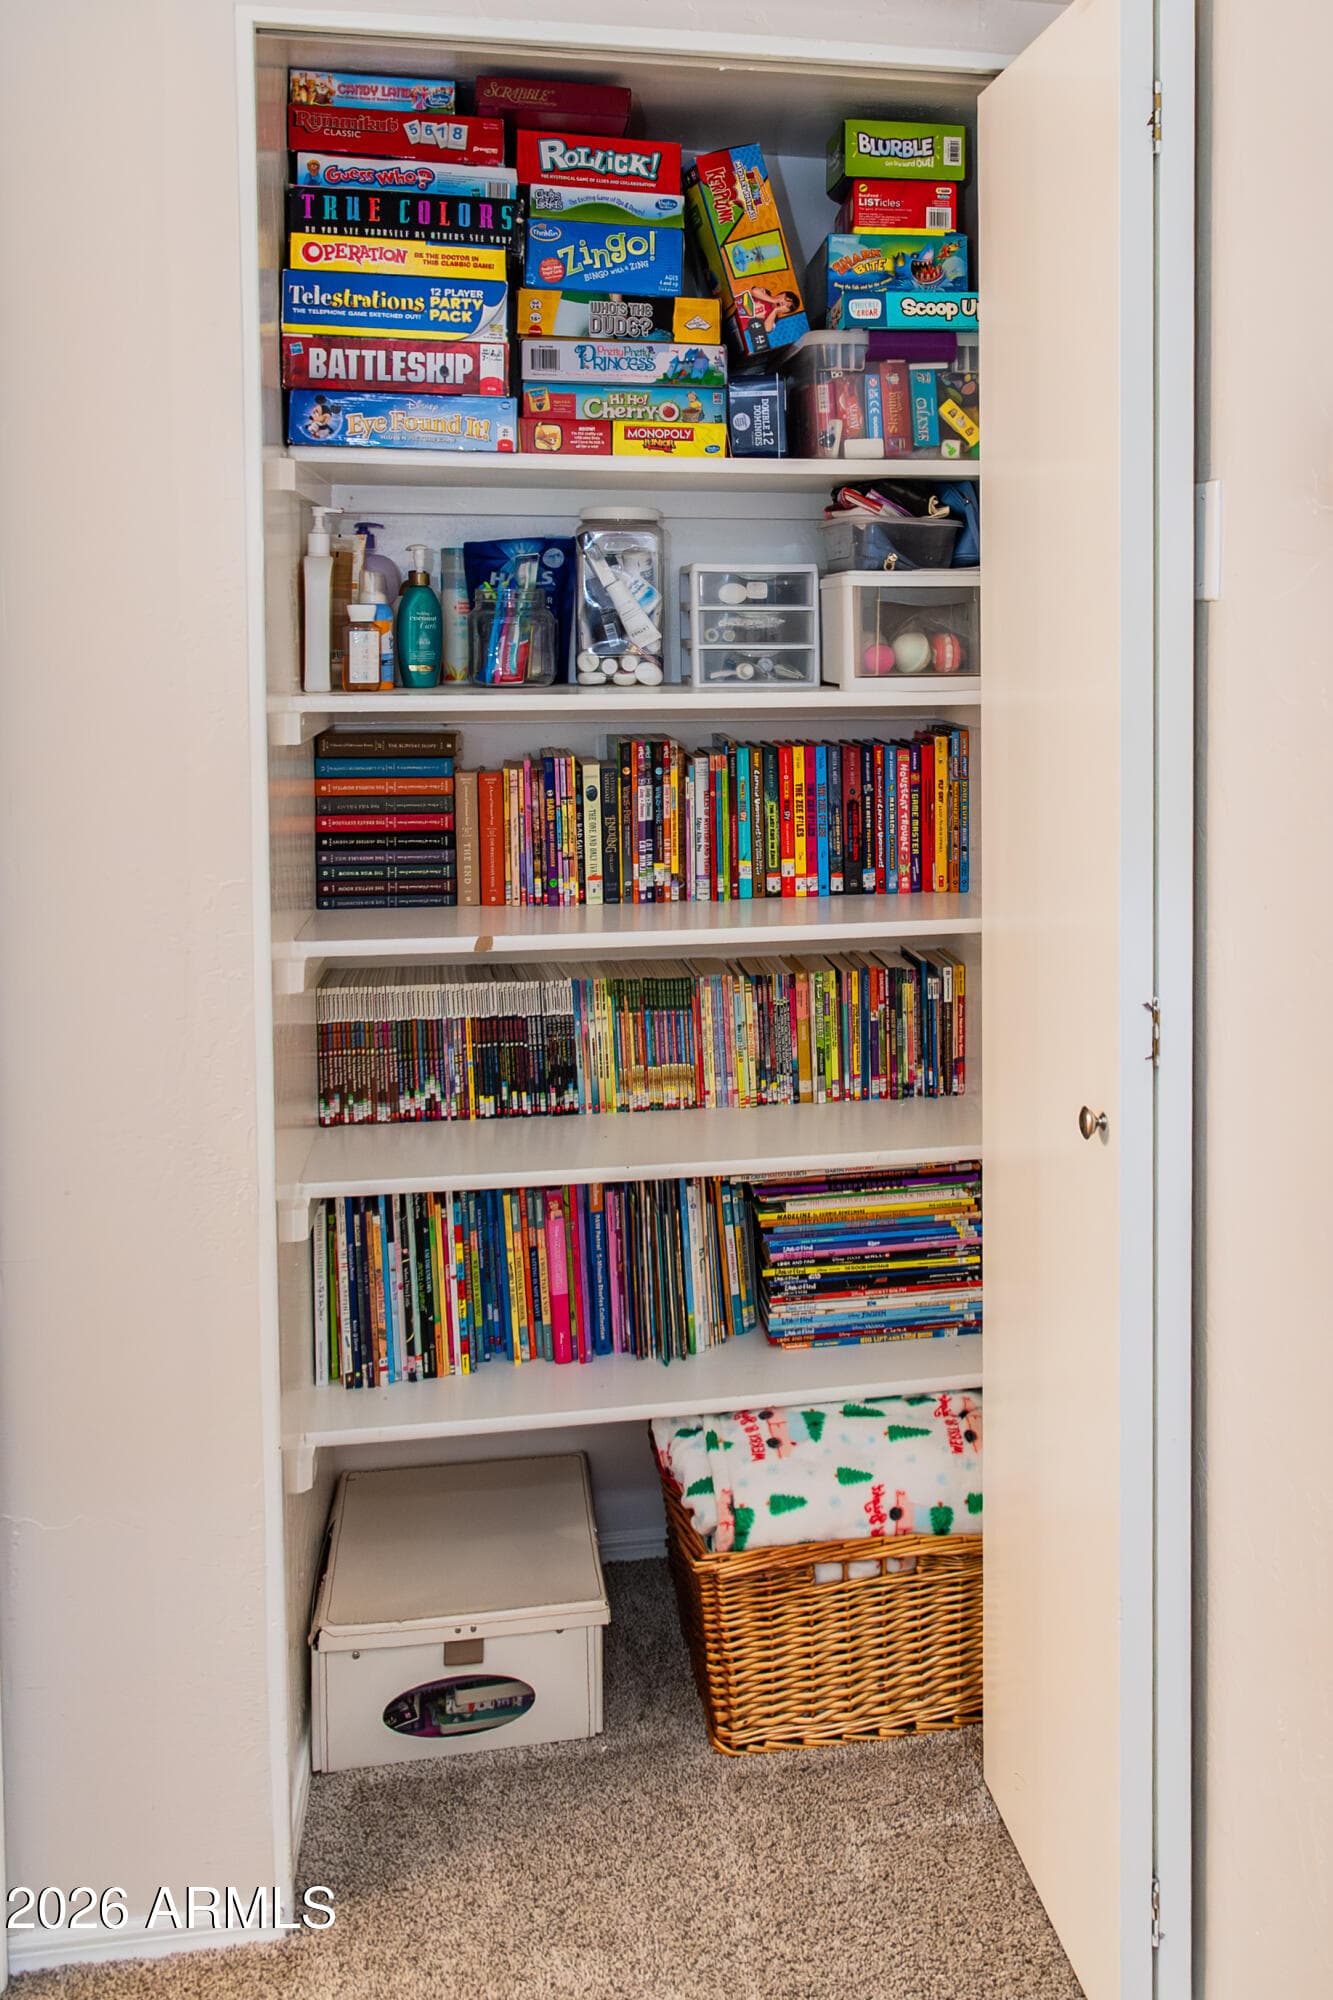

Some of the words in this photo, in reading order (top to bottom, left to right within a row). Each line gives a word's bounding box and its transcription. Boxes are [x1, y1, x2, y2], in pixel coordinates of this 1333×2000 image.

[337, 83, 379, 96] CANDY
[484, 82, 549, 102] SCRABBLE
[295, 110, 399, 133] Rummikub
[409, 123, 417, 135] 5
[425, 123, 433, 135] 6
[452, 127, 462, 139] 8
[323, 129, 361, 138] CLASSIC
[858, 132, 934, 159] BLURBLE
[301, 194, 381, 222] TRUE
[400, 200, 512, 230] COLORS
[344, 227, 359, 235] SEE
[365, 228, 409, 238] YOURSELF
[415, 230, 425, 239] AS
[430, 231, 464, 241] OTHERS
[469, 234, 484, 243] SEE
[490, 235, 512, 244] YOU?
[302, 242, 408, 265] OPERATION
[557, 231, 656, 276] Zingo!
[832, 249, 881, 276] SHARK
[584, 270, 609, 281] BINGO
[629, 261, 649, 270] ZING
[853, 258, 887, 274] BITE
[289, 285, 425, 313] Telestrations
[430, 288, 441, 296] 12
[444, 289, 483, 299] PLAYER
[430, 296, 483, 310] PARTY
[430, 310, 472, 323] PACK
[590, 301, 627, 315] WHO'S
[629, 303, 653, 316] THE
[901, 297, 958, 321] Scoop
[961, 298, 979, 321] U
[589, 315, 653, 337] DUDE?
[575, 345, 656, 372] PRINCESS
[596, 346, 623, 357] Pretty
[623, 347, 655, 358] Pretty
[309, 348, 473, 384] BATTLESHIP
[610, 394, 624, 405] Hi
[627, 394, 648, 405] Ho!
[754, 405, 762, 446] DOMINOES
[761, 399, 770, 431] DOUBLE
[347, 413, 387, 440] Eye
[390, 411, 461, 434] Found
[464, 417, 490, 441] It!
[627, 429, 692, 439] MONOPOLY
[644, 440, 675, 448] JUNIOR
[762, 432, 774, 445] 12
[795, 783, 803, 798] THE
[900, 764, 909, 810] HOUSECAT
[547, 798, 556, 821] BARB
[588, 809, 596, 820] THE
[795, 799, 803, 813] ZEE
[604, 815, 617, 853] ENDLING
[900, 812, 910, 852] TROUBLE
[598, 1308, 606, 1340] Collection
